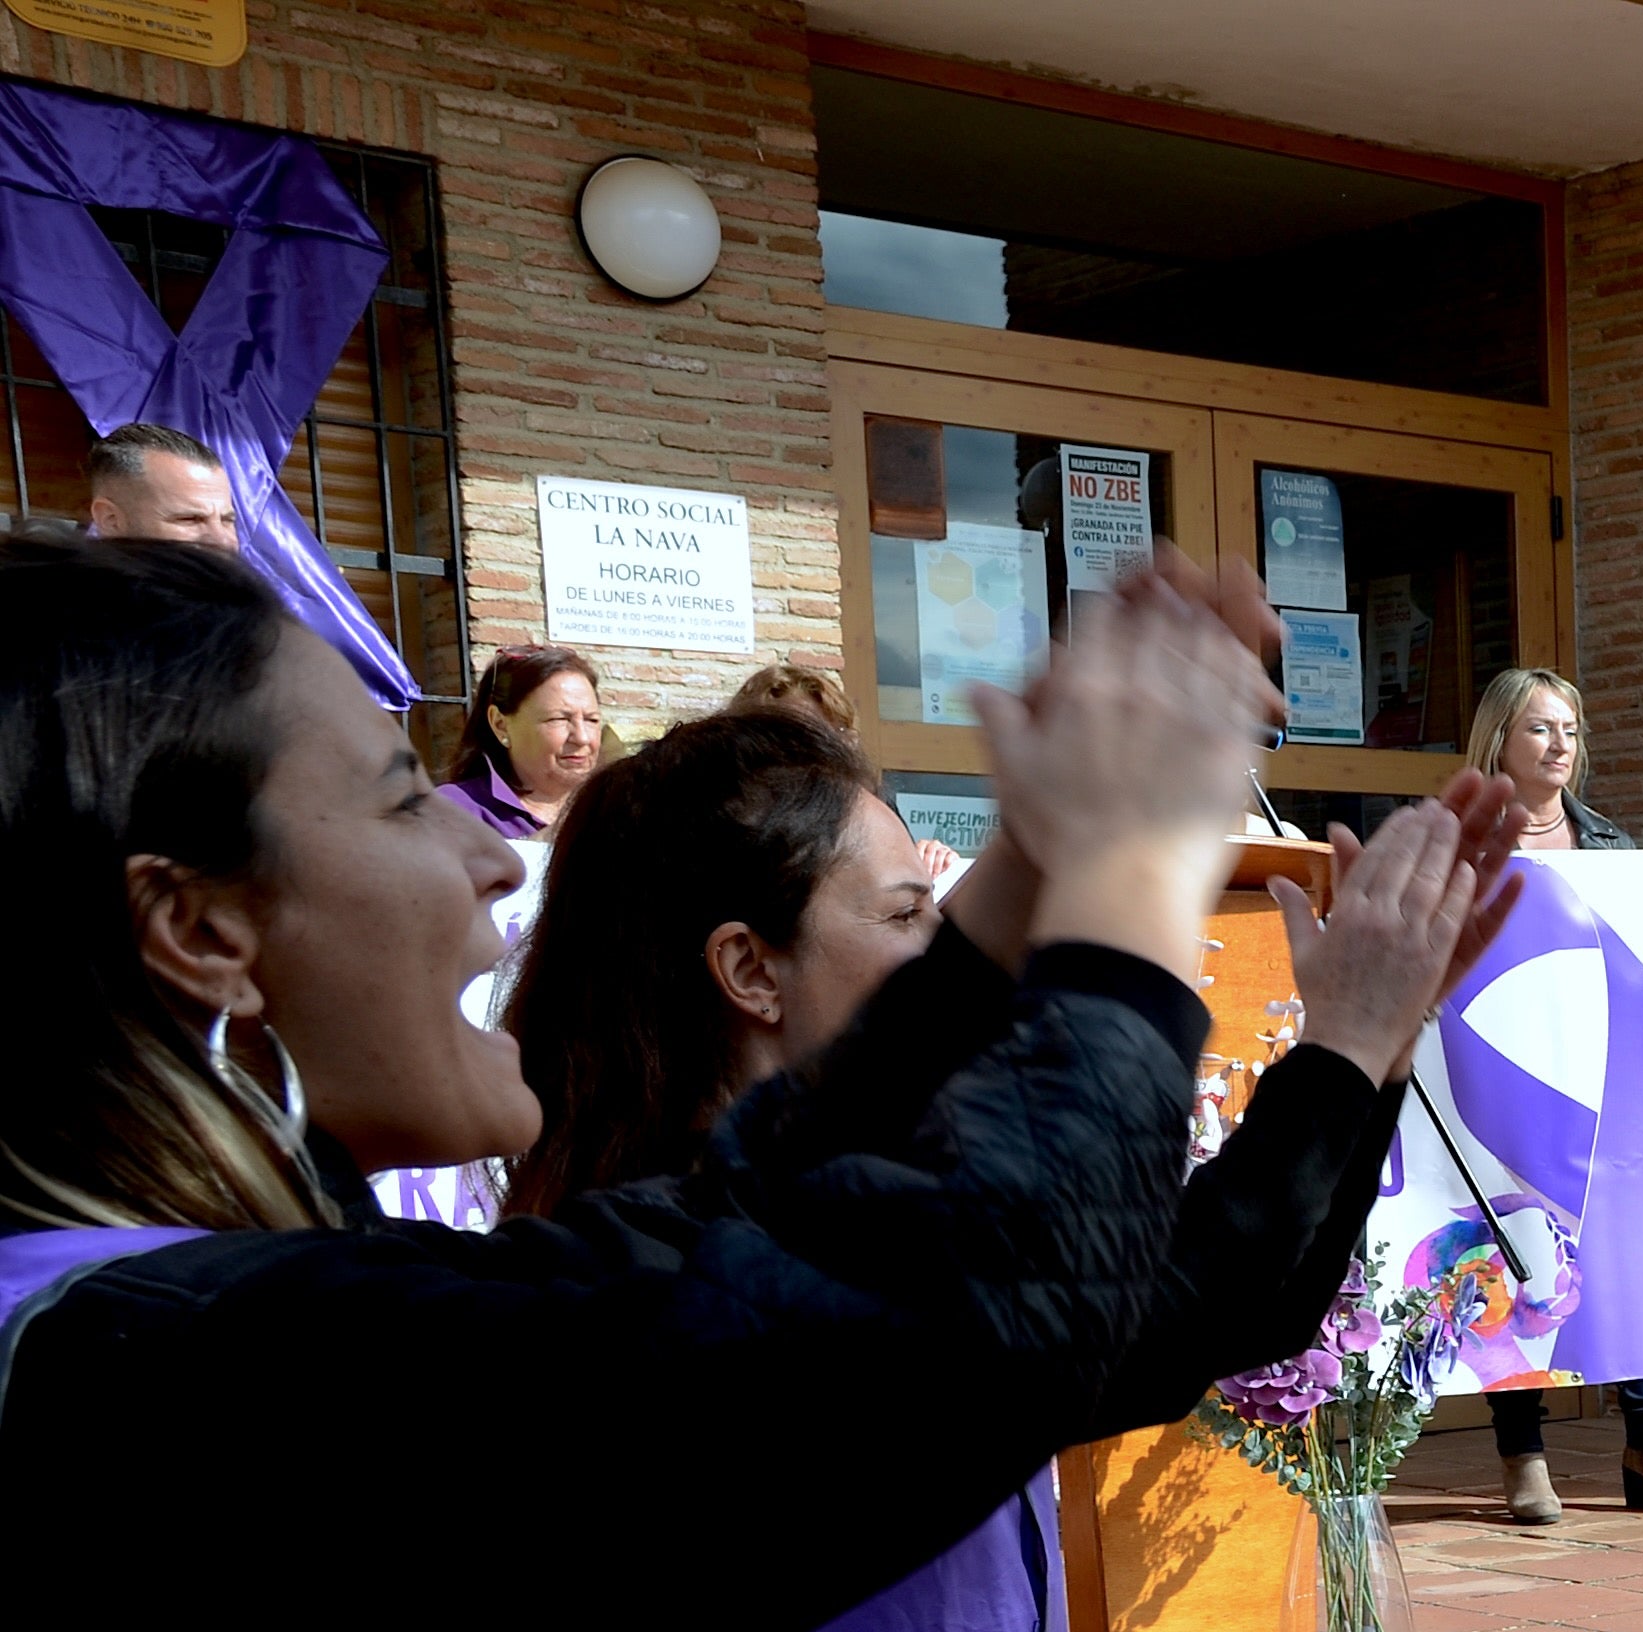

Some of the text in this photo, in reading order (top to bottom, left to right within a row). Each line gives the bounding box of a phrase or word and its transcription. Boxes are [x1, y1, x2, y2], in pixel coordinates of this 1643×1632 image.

[1070, 457, 1139, 476] MANIFESTACIÓN
[1069, 474, 1142, 504] NO ZBE
[1270, 476, 1331, 497] Alcohólicos
[547, 489, 741, 527] CENTRO SOCIAL
[1271, 491, 1325, 511] Anónimos
[1071, 530, 1109, 543] CONTRA
[1110, 533, 1122, 545] LA
[1116, 521, 1128, 532] EN
[1129, 522, 1144, 534] PIE
[594, 524, 702, 554] LA NAVA
[599, 562, 701, 587] HORARIO
[566, 586, 735, 613] DE LUNES A VIERNES
[556, 606, 603, 618] MAÑANAS
[643, 613, 677, 625] HORAS
[642, 628, 677, 639] HORAS
[712, 633, 746, 645] HORAS
